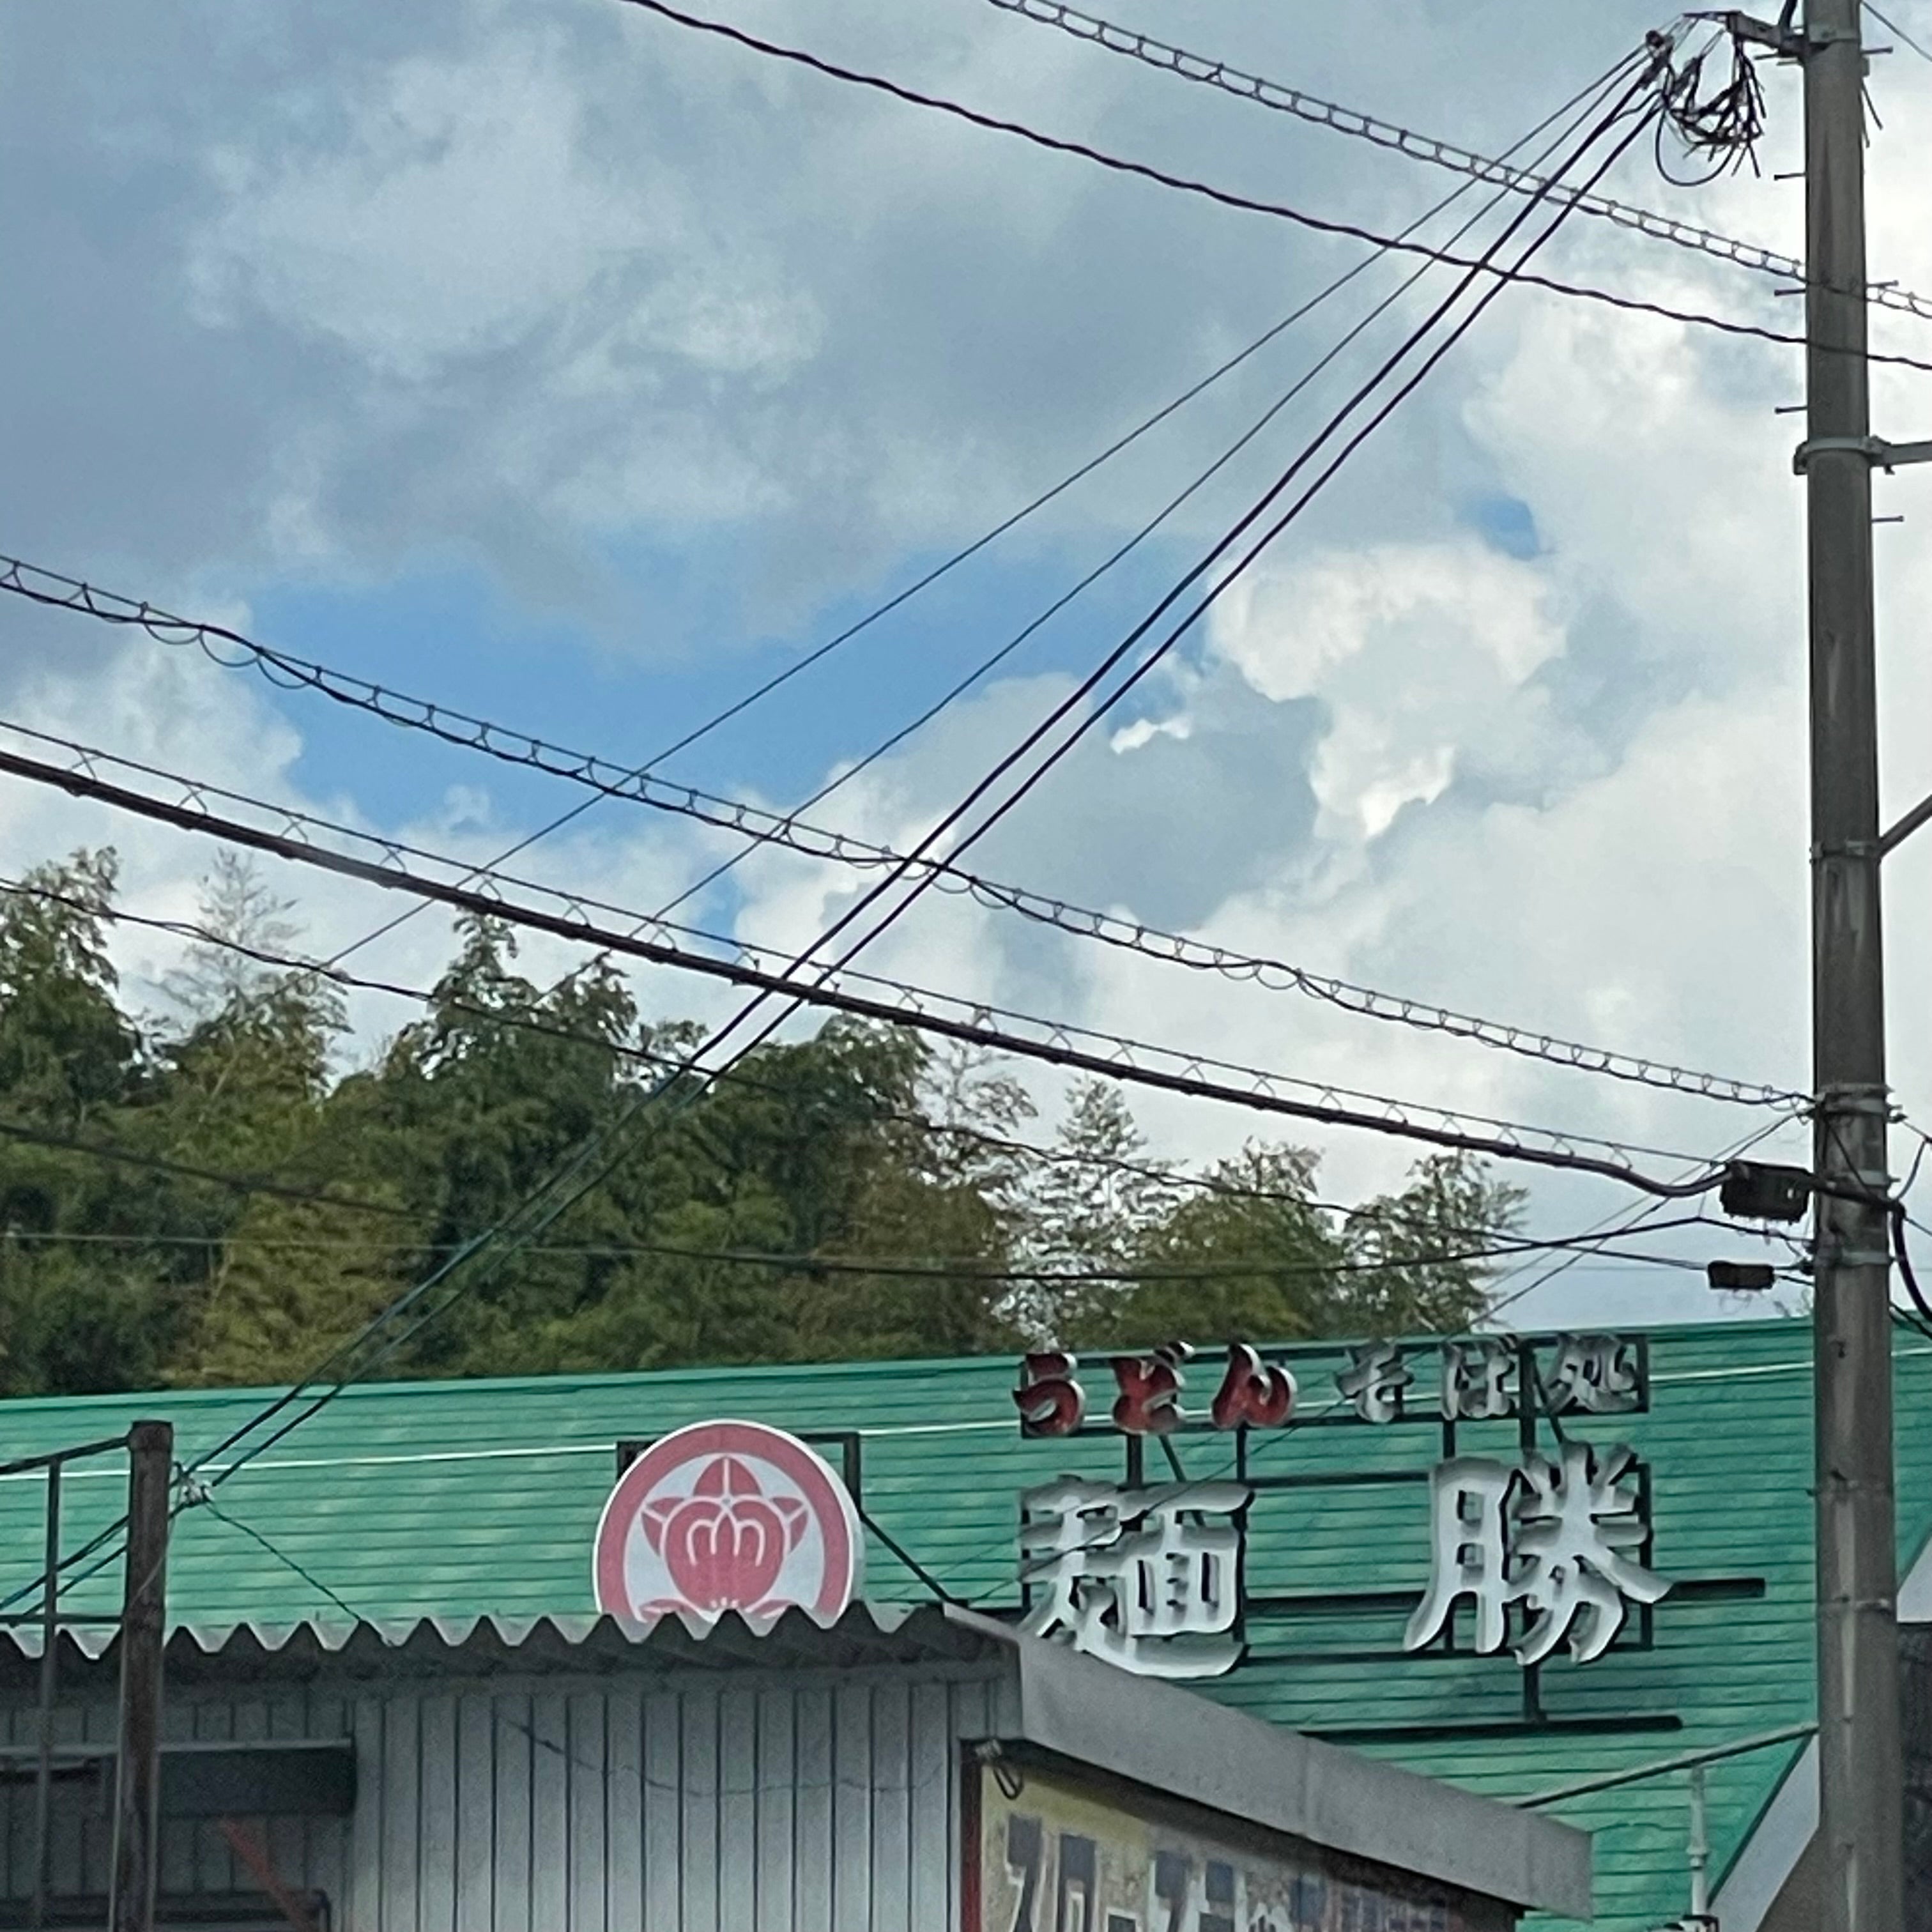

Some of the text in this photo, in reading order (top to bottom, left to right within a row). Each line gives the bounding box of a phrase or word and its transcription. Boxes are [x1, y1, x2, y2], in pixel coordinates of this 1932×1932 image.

[1013, 1333, 1639, 1436] うどん そば処
